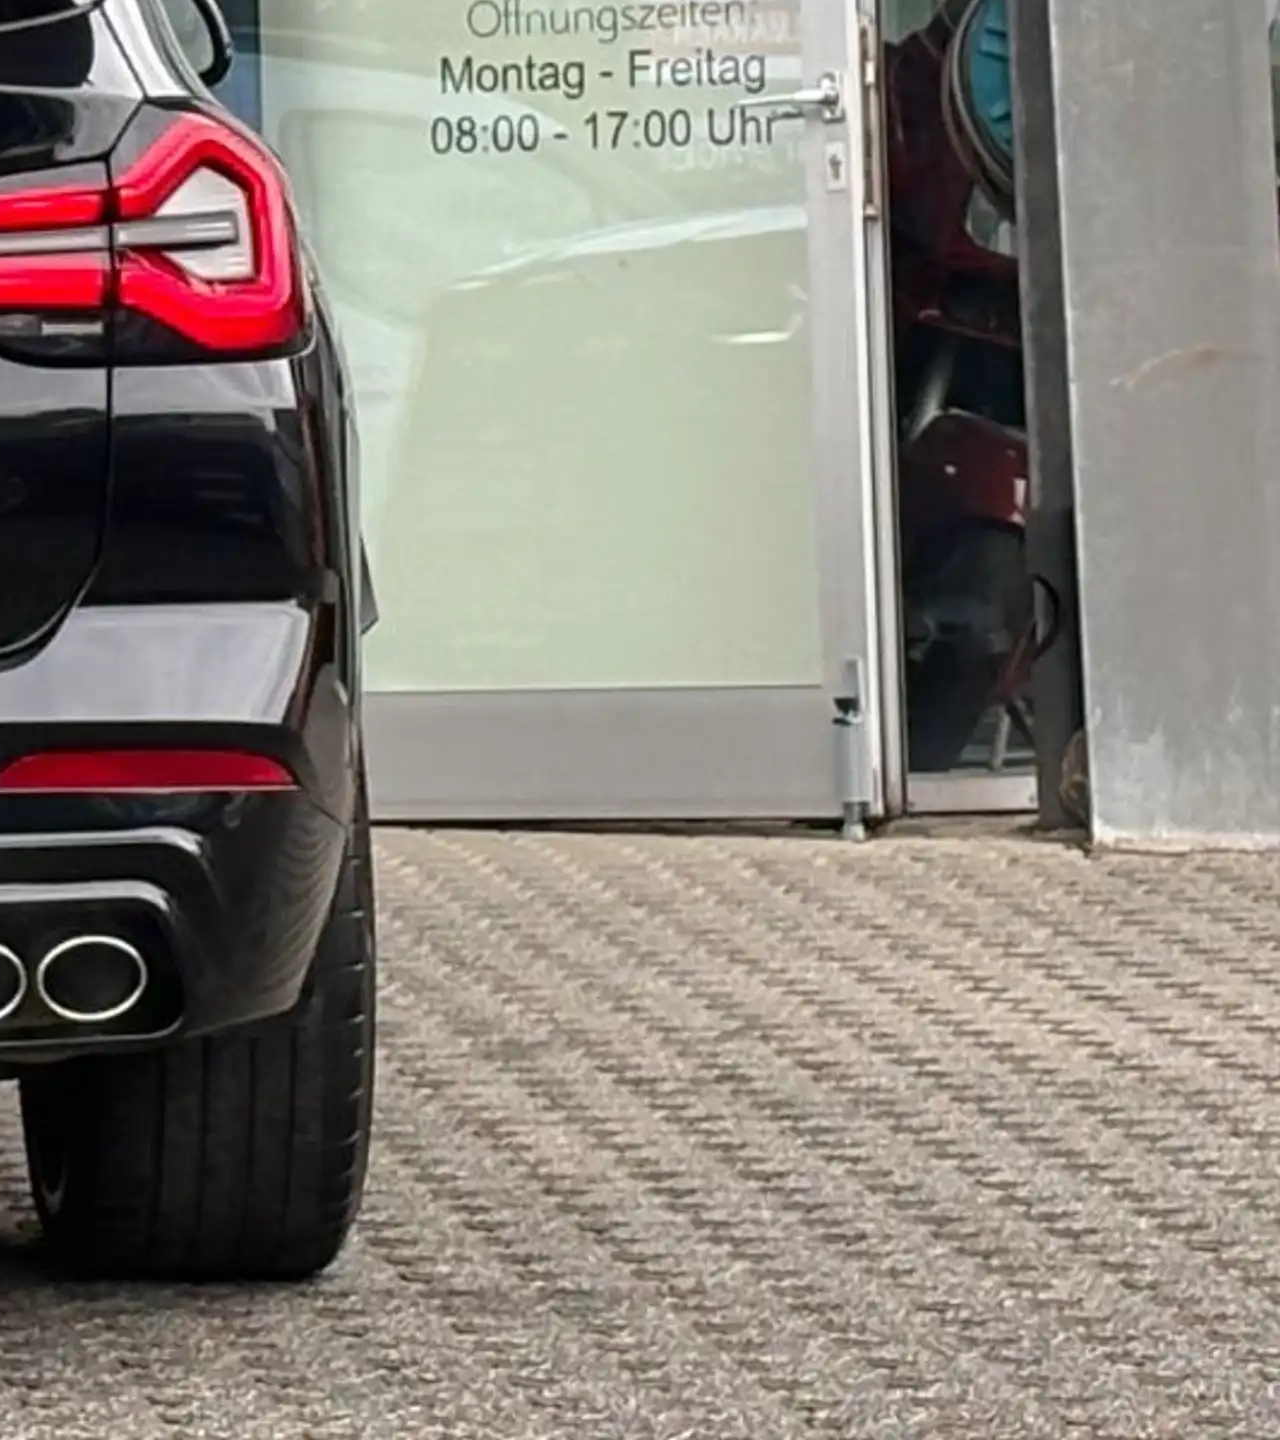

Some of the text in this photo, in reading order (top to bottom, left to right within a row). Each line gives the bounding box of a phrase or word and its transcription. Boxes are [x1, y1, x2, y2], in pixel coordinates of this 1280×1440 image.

[440, 55, 587, 99] Montag
[629, 48, 766, 94] Freitag
[431, 114, 540, 154] 08:00
[584, 109, 692, 150] 17:00
[707, 107, 778, 146] Uhr
